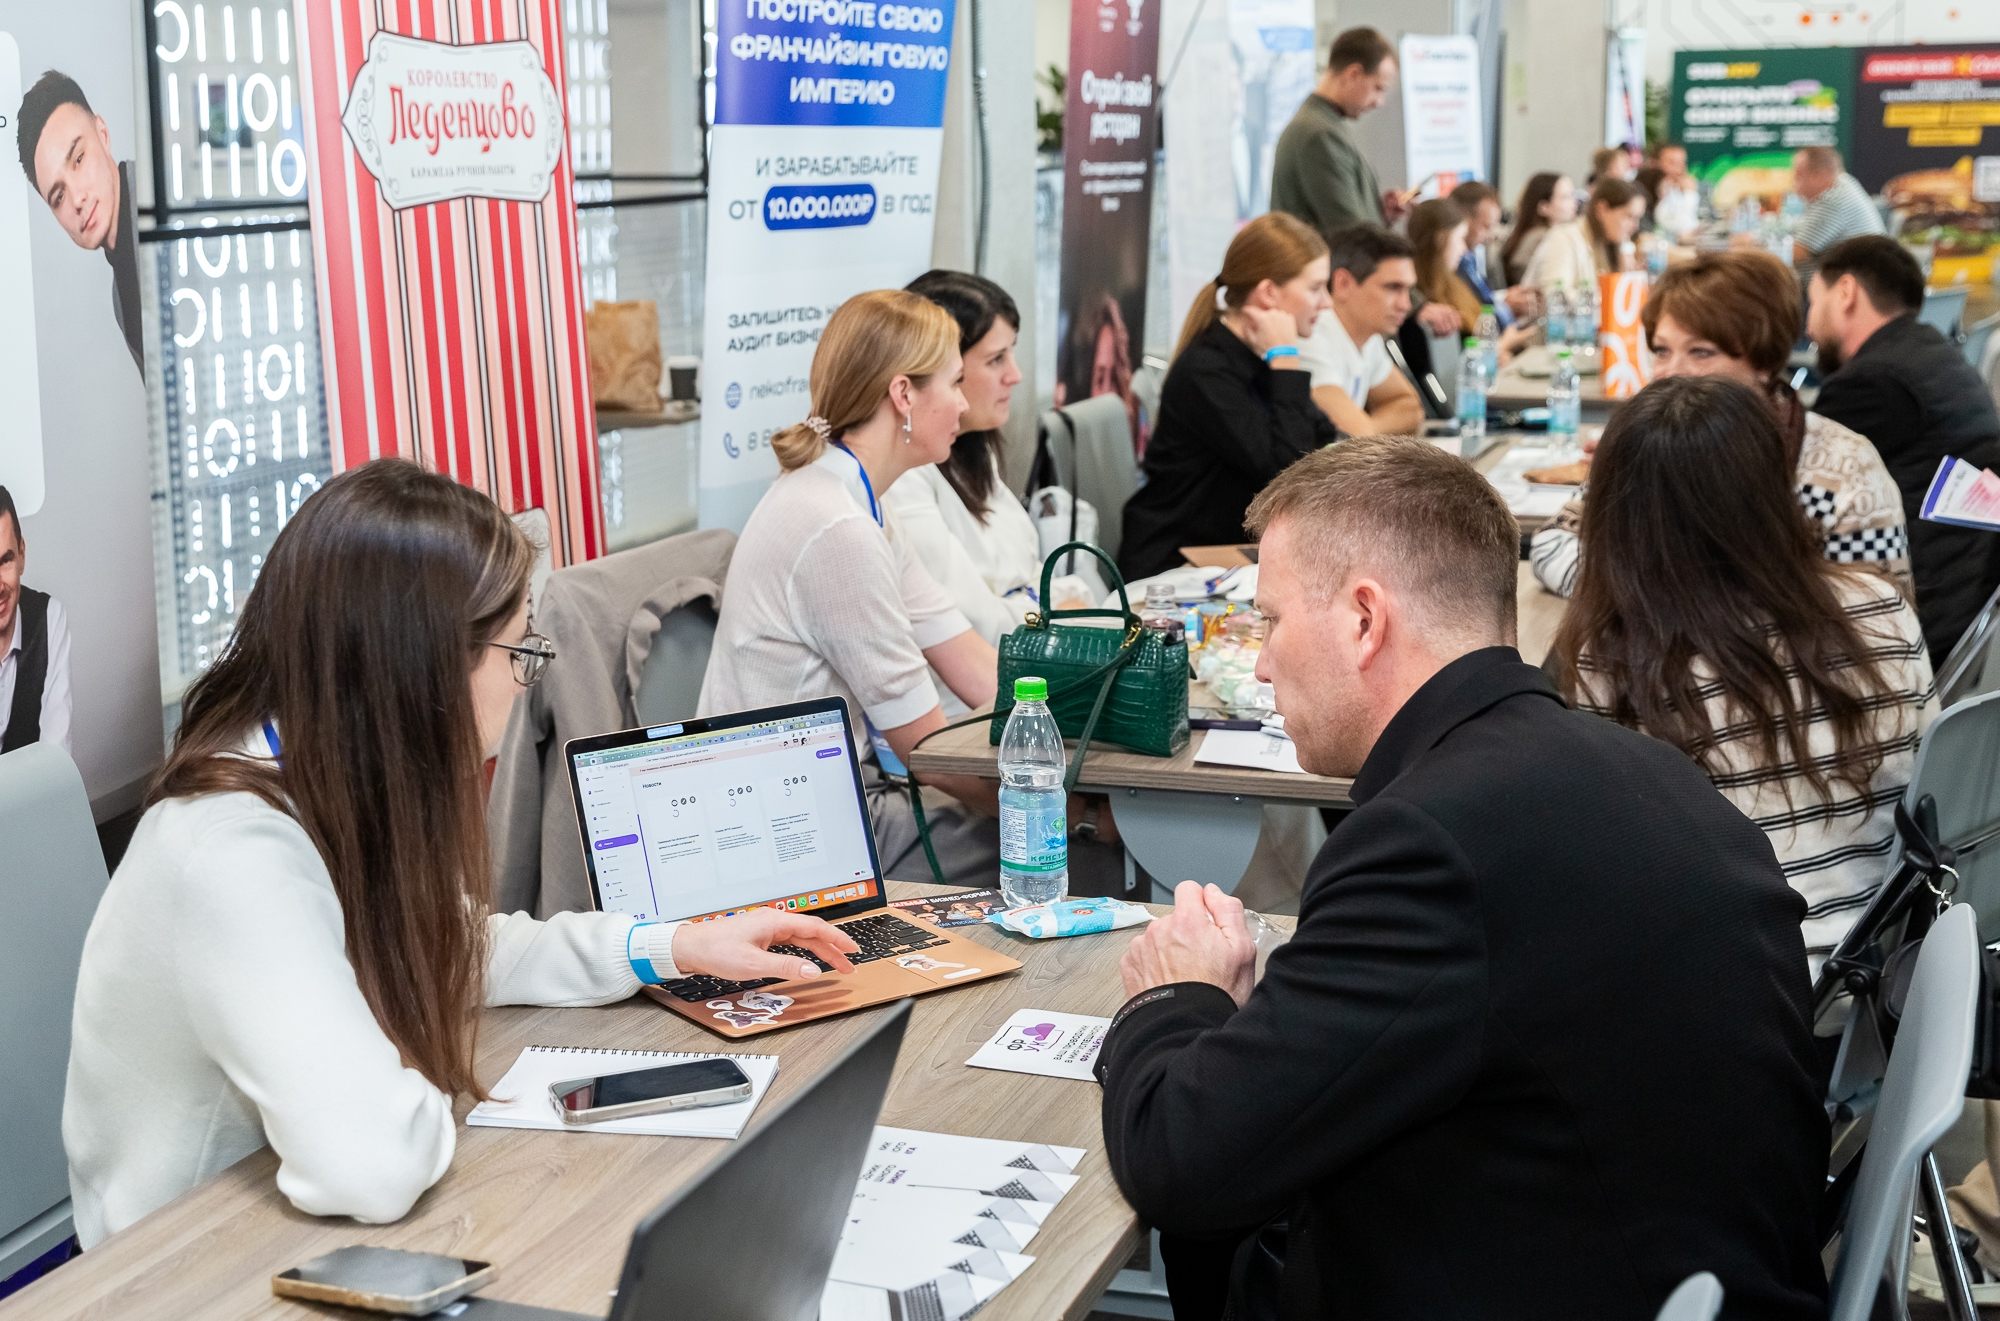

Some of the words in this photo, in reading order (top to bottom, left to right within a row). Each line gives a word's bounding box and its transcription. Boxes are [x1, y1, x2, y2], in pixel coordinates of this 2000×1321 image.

[746, 0, 876, 28] ПОСТРОЙТЕ
[878, 4, 944, 33] СВОЮ
[730, 32, 949, 71] ФРАНЧАЙЗИНГОВУЮ
[407, 69, 499, 90] КОРОЛЕВСТВО
[790, 77, 896, 106] ИМПЕРИЮ
[389, 80, 536, 156] Леденцово
[756, 157, 770, 176] И
[775, 151, 919, 177] ЗАРАБАТЫВАЙТЕ
[729, 200, 757, 219] ОТ
[883, 194, 894, 214] В
[900, 193, 931, 215] ГОД
[728, 306, 823, 329] ЗАПИШИТЕСЬ
[727, 333, 773, 352] АУДИТ
[776, 328, 823, 346] БИЗНЕ
[750, 375, 809, 400] nekofra
[642, 781, 662, 789] Новости
